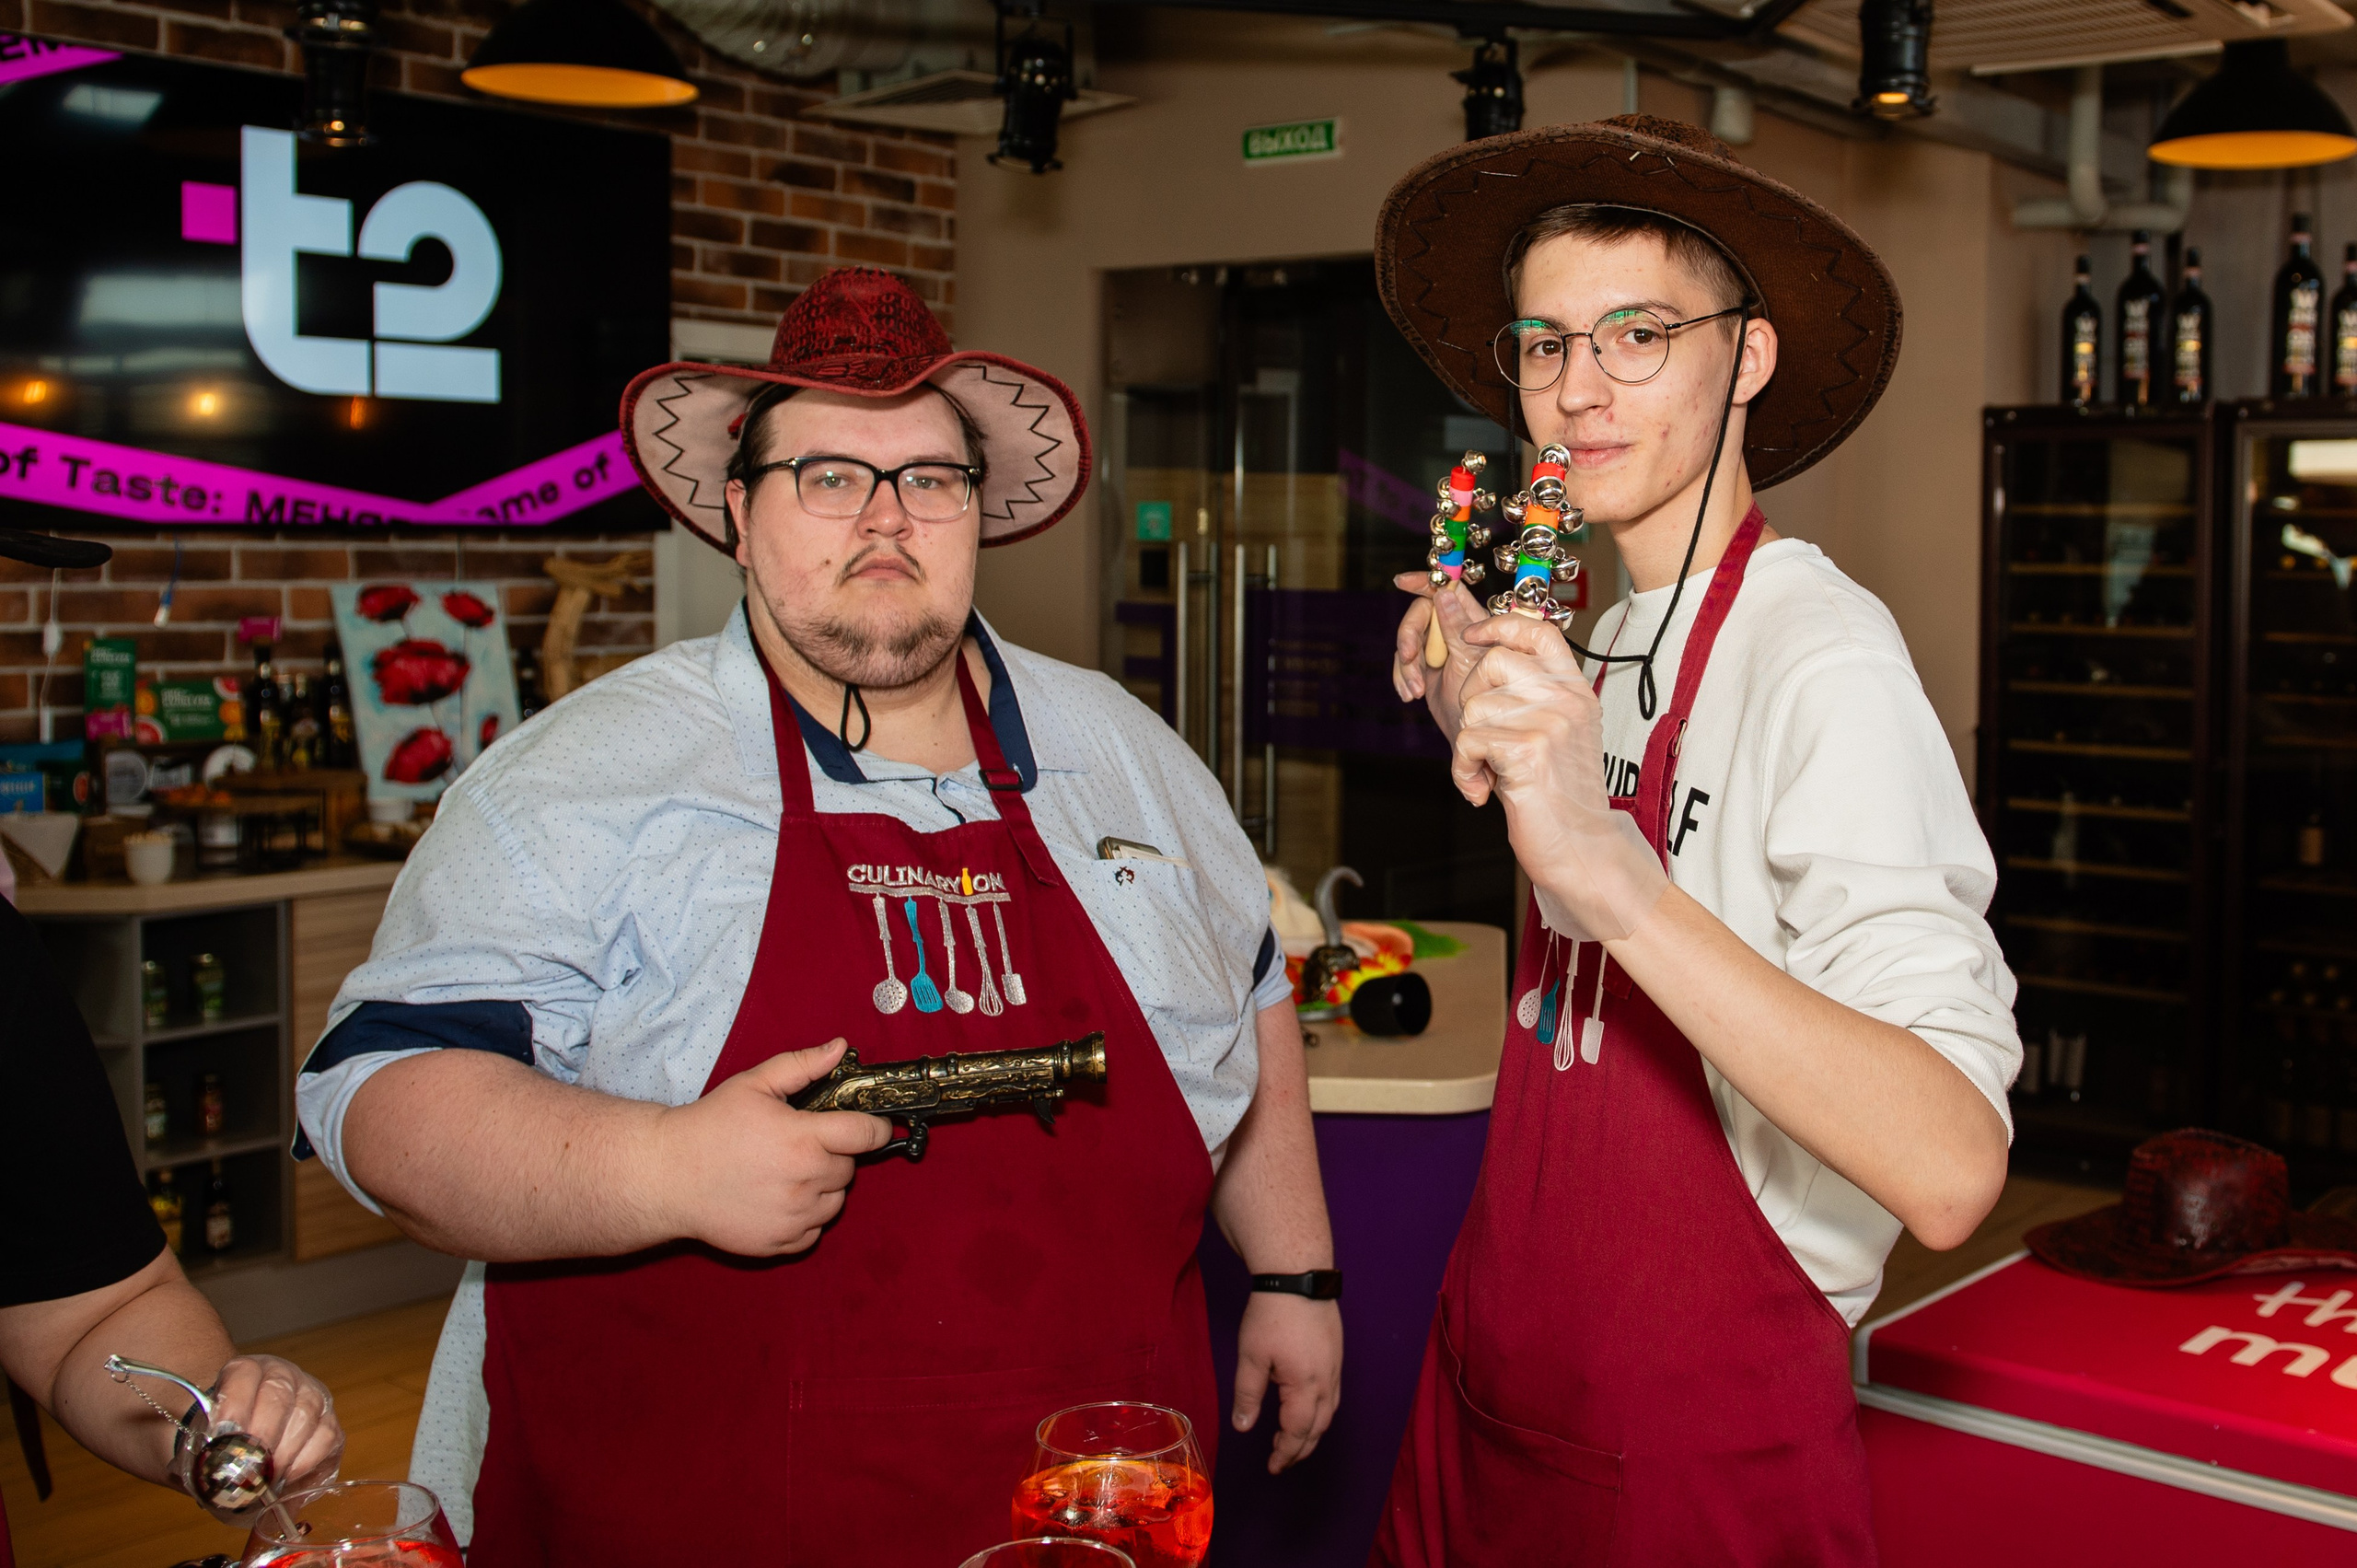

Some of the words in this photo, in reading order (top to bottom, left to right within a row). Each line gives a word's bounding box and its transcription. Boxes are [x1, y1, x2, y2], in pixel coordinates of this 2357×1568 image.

[1248, 124, 1328, 156] ВЫХОД
[59, 453, 223, 516] Taste:
[573, 450, 609, 492] of
